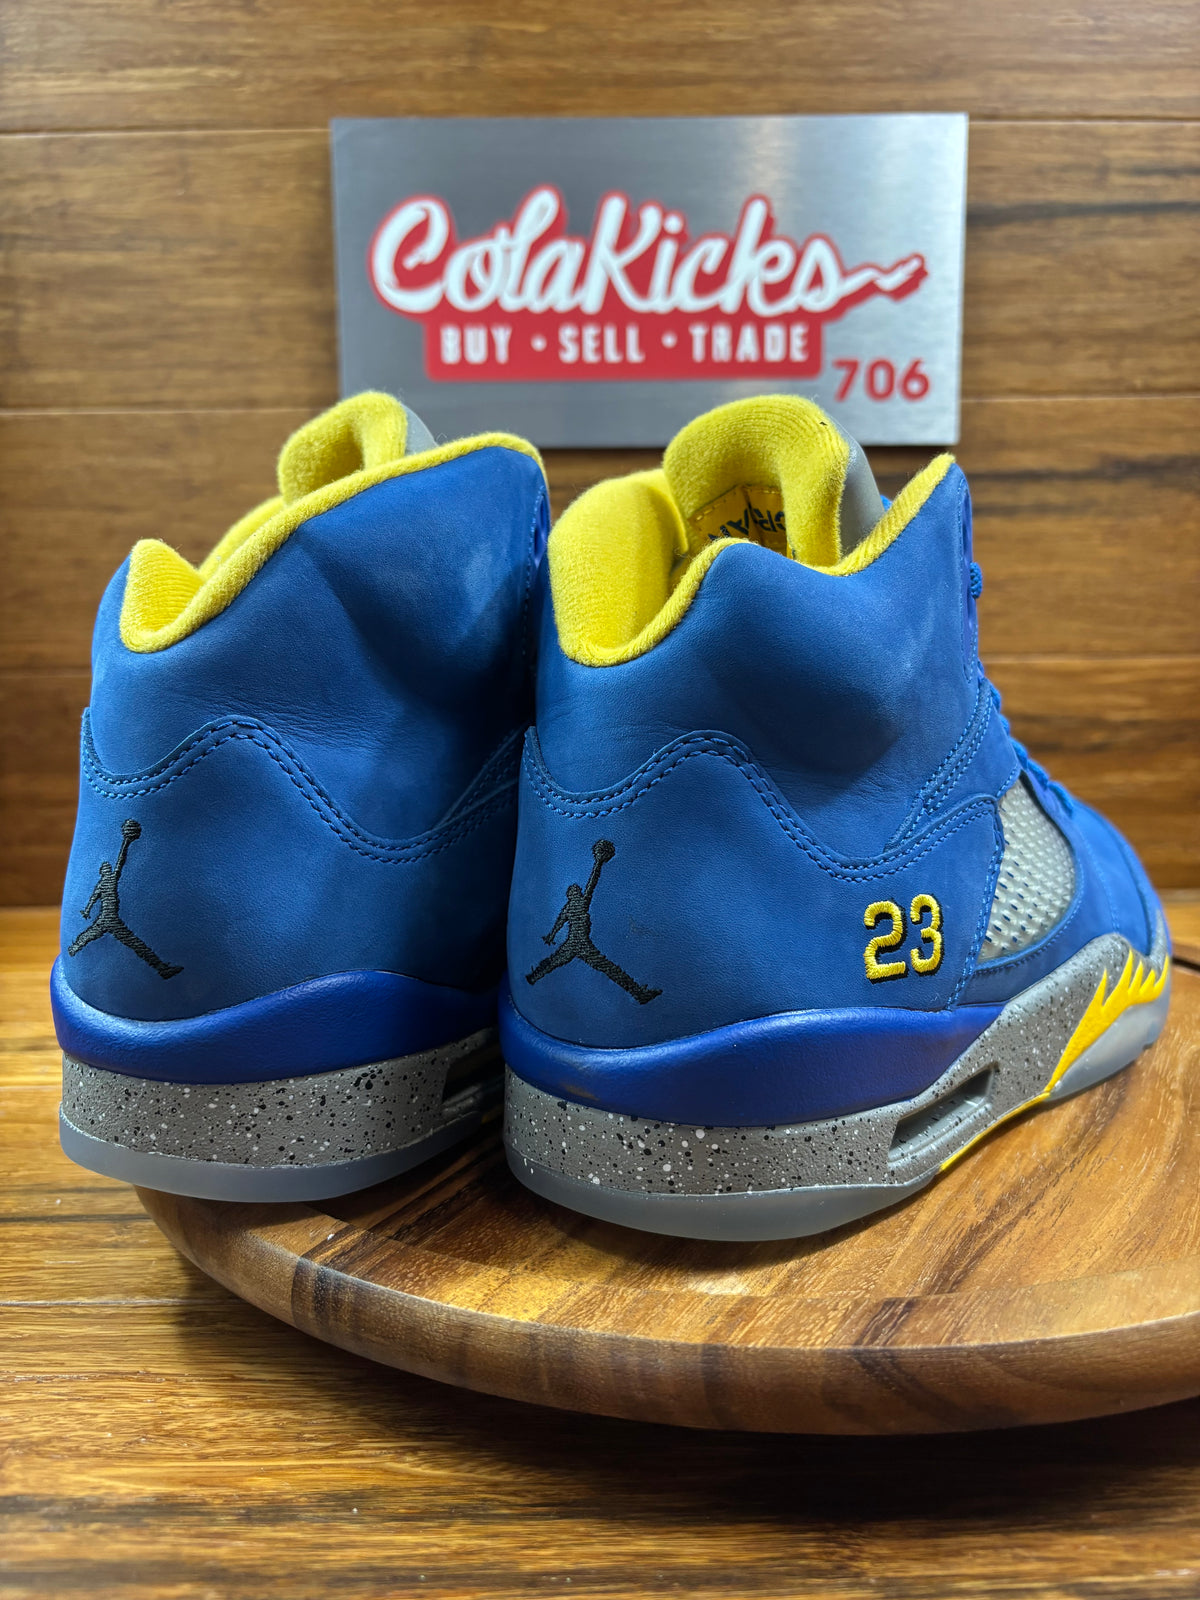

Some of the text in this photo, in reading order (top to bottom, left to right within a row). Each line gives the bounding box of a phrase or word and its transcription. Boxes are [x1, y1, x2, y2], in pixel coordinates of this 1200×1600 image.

[369, 187, 923, 318] ColaKicks
[439, 322, 810, 365] BUY SELL TRADE
[831, 357, 931, 402] 706
[862, 893, 945, 984] 23
